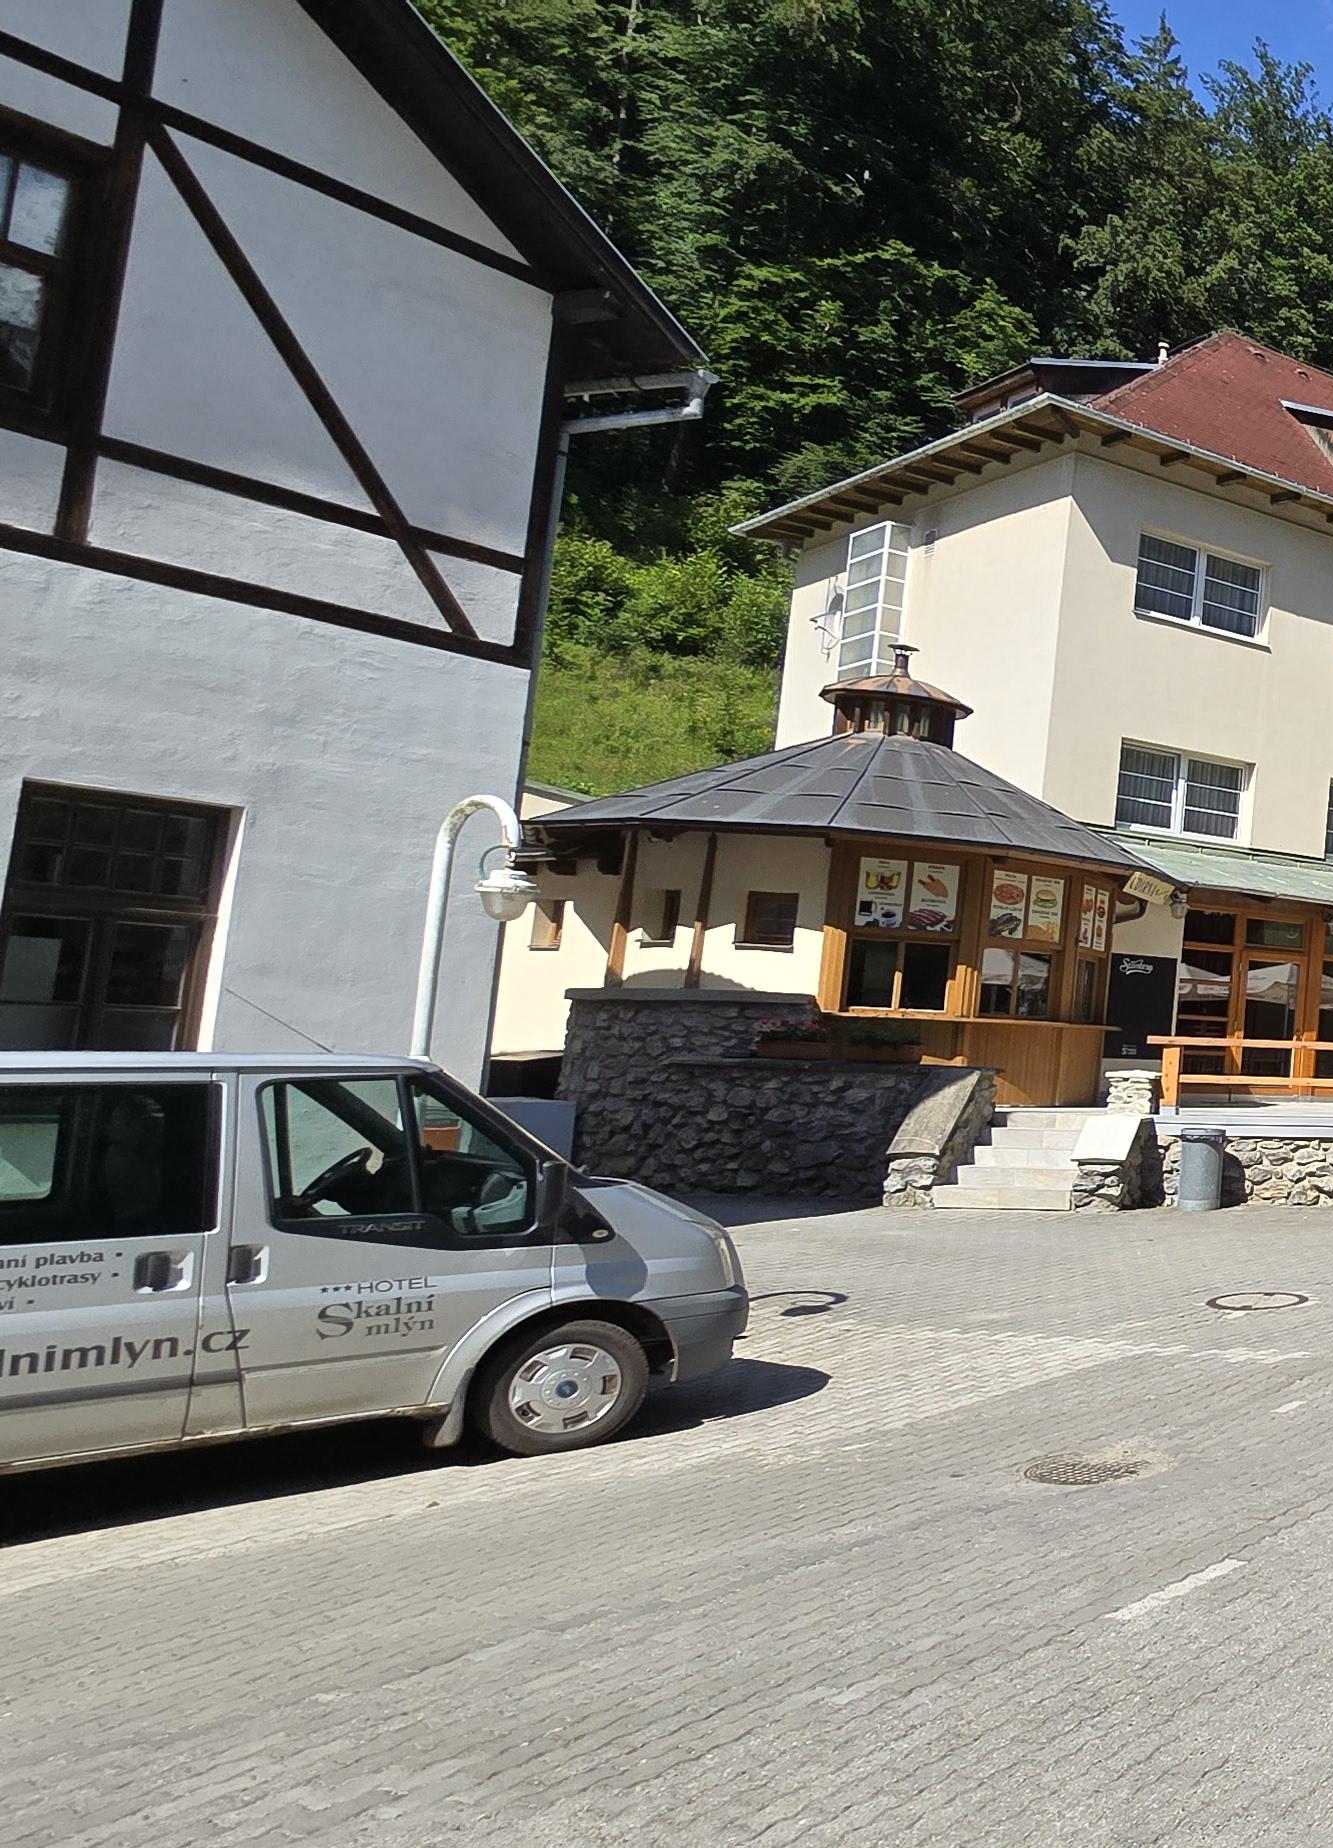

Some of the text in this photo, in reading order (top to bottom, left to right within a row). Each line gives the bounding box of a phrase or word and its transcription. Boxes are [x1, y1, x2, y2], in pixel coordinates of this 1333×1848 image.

[338, 1220, 426, 1234] TRANSIT
[35, 1251, 104, 1269] plavba
[357, 1275, 438, 1294] HOTEL
[316, 1294, 436, 1340] Skalní
[365, 1316, 435, 1337] mlýn
